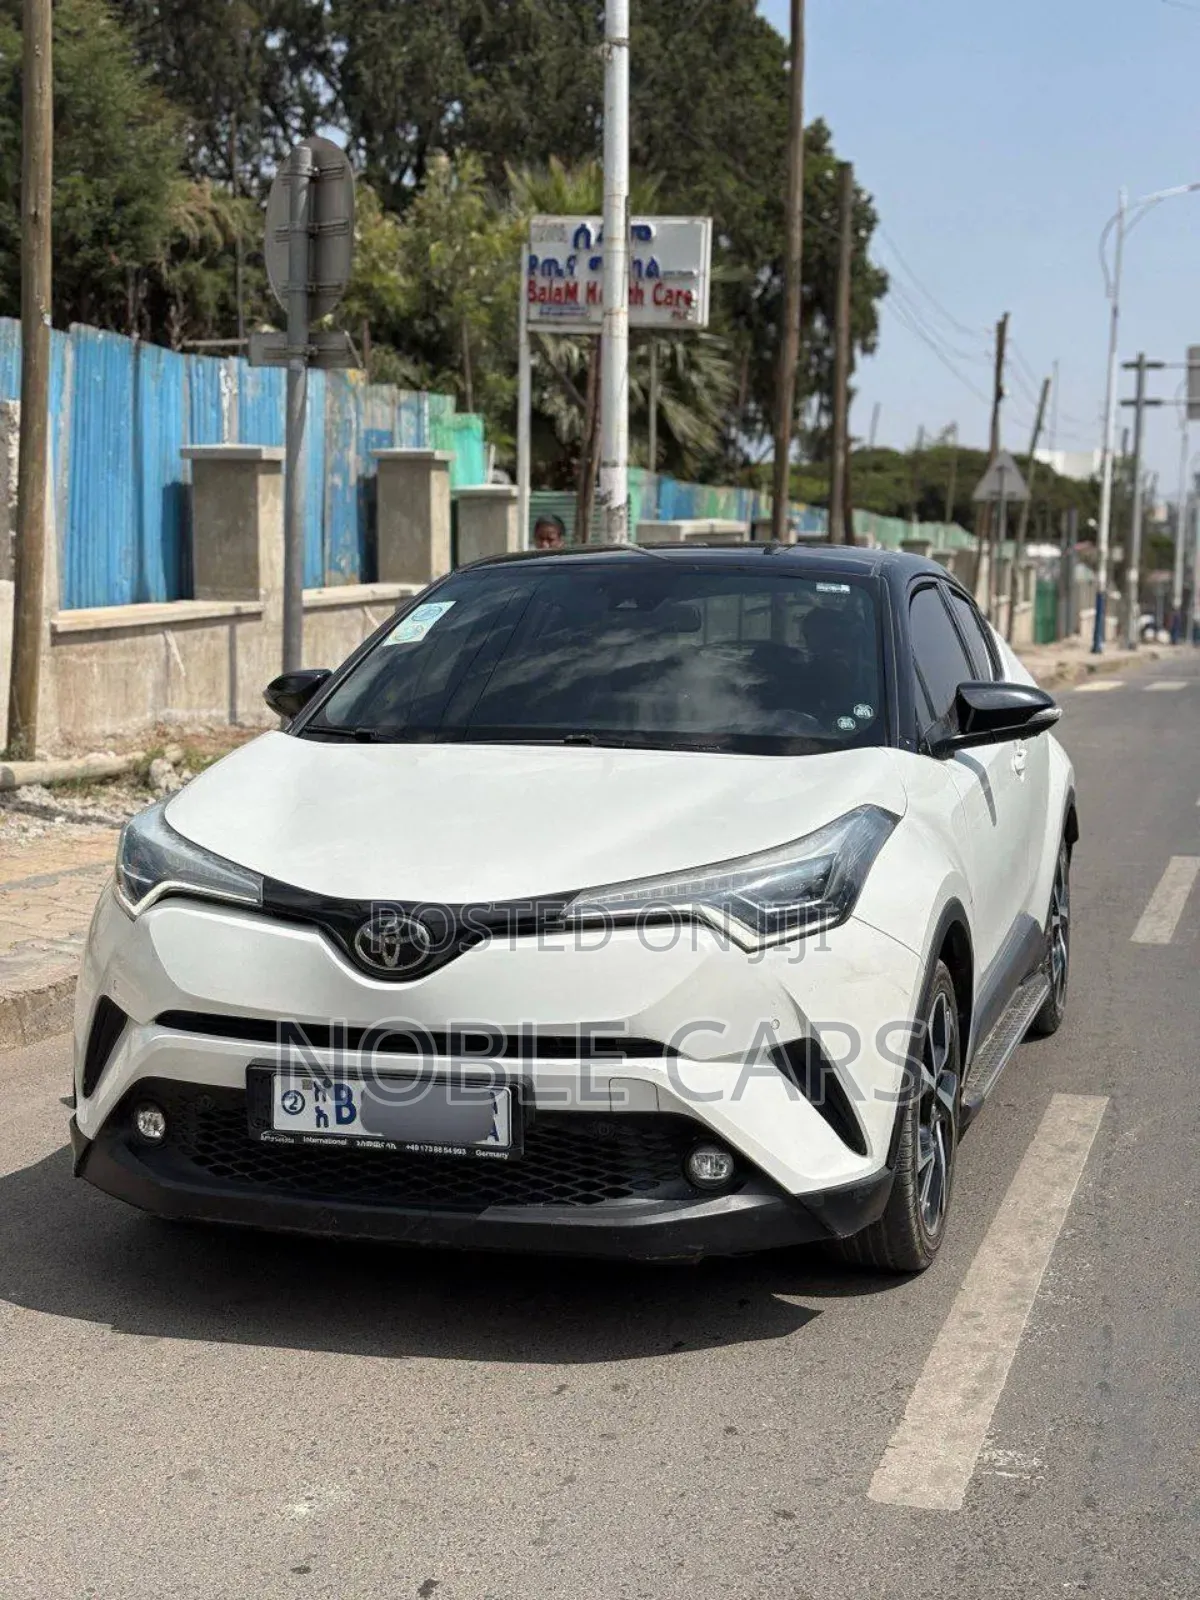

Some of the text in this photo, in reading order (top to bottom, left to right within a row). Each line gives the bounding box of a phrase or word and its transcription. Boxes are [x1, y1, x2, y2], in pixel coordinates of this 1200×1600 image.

[653, 282, 693, 306] Care
[303, 1135, 347, 1146] International
[475, 1149, 509, 1160] Germany
